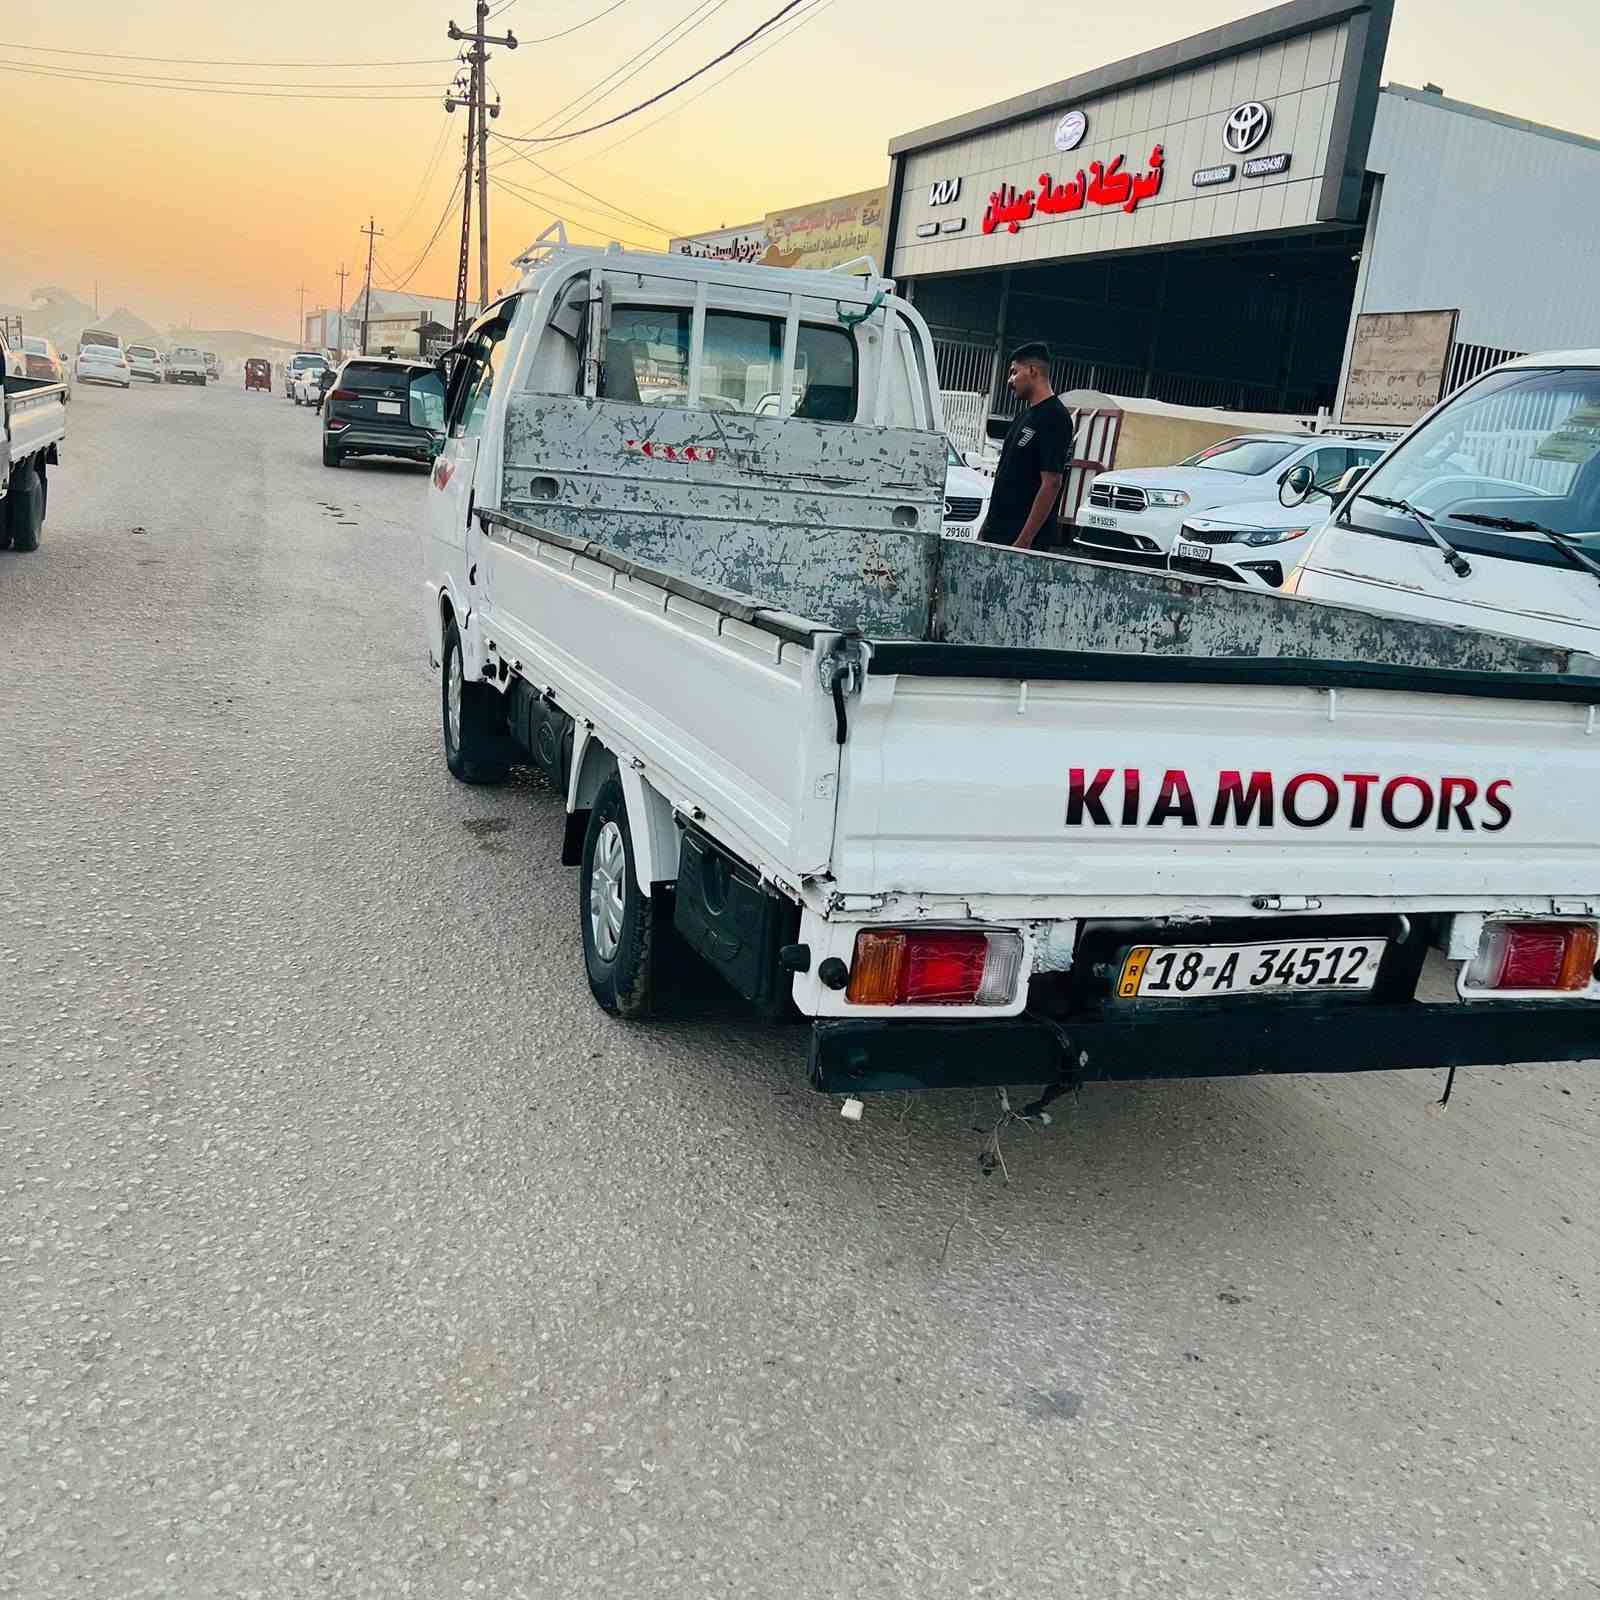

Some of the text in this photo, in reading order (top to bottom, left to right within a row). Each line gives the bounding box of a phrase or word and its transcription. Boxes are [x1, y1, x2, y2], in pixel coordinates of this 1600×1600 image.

[1087, 144, 1165, 213] شركة
[945, 527, 970, 538] 29160
[1065, 767, 1514, 832] KIA MOTORS
[1249, 946, 1370, 987] 34512
